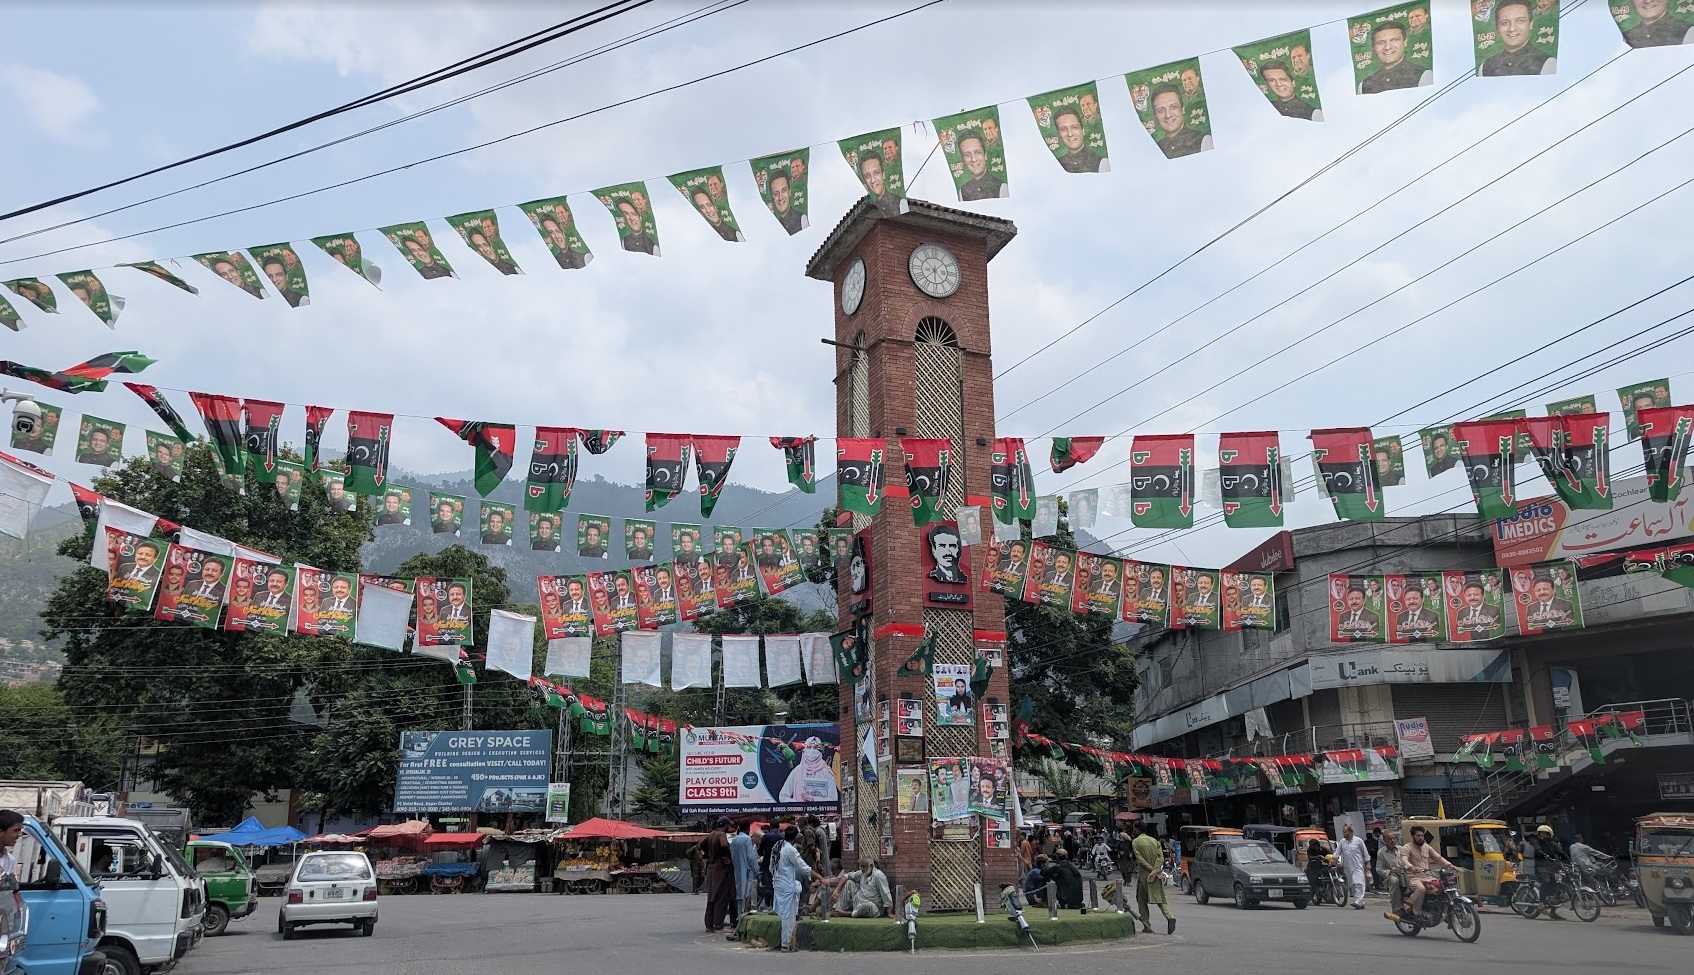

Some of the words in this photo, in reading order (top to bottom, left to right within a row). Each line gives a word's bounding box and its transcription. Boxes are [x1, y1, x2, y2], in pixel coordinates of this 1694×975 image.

[1612, 487, 1648, 499] Cochlear
[1504, 517, 1556, 540] MEDICS
[1261, 549, 1282, 568] Jubilee
[1400, 721, 1424, 736] Audio
[1404, 728, 1427, 737] MEDICS
[448, 737, 485, 748] GREY
[486, 736, 531, 748] SPACE
[410, 760, 423, 768] first
[424, 758, 448, 768] FREE
[686, 757, 714, 765] CHILD'S
[714, 756, 741, 764] FUTURE
[685, 777, 707, 785] PLAY
[708, 776, 739, 785] GROUP
[686, 788, 718, 798] CLASS
[719, 787, 736, 797] 9th
